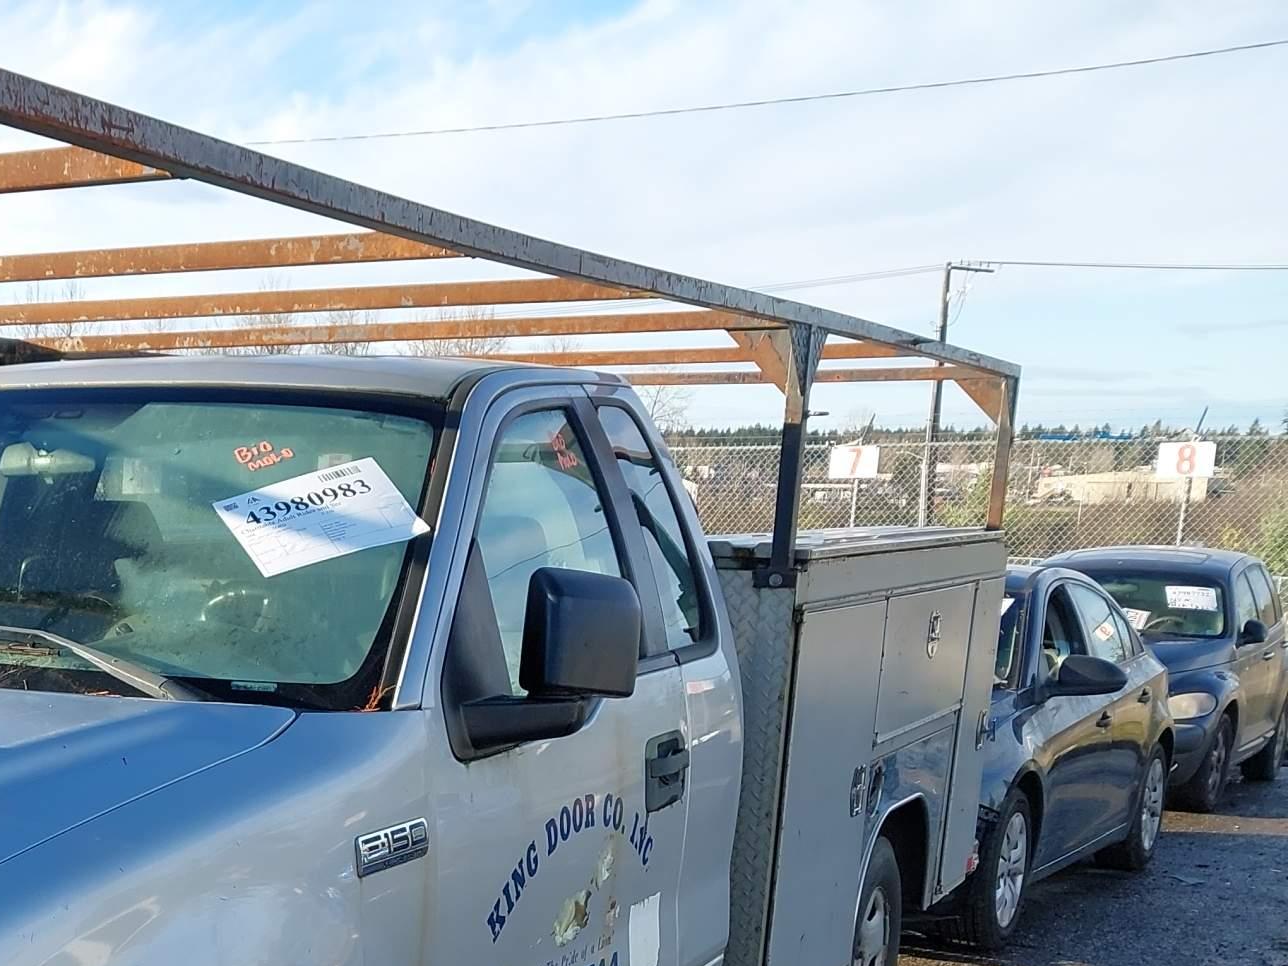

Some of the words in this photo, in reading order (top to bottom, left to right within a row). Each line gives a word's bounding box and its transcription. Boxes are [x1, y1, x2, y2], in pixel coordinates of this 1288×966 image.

[848, 448, 863, 475] 7
[1176, 444, 1195, 475] 8
[244, 478, 373, 527] 43980983
[485, 839, 539, 944] KING
[544, 793, 596, 857] DOOR
[602, 792, 626, 835] CO.
[580, 945, 588, 961] of
